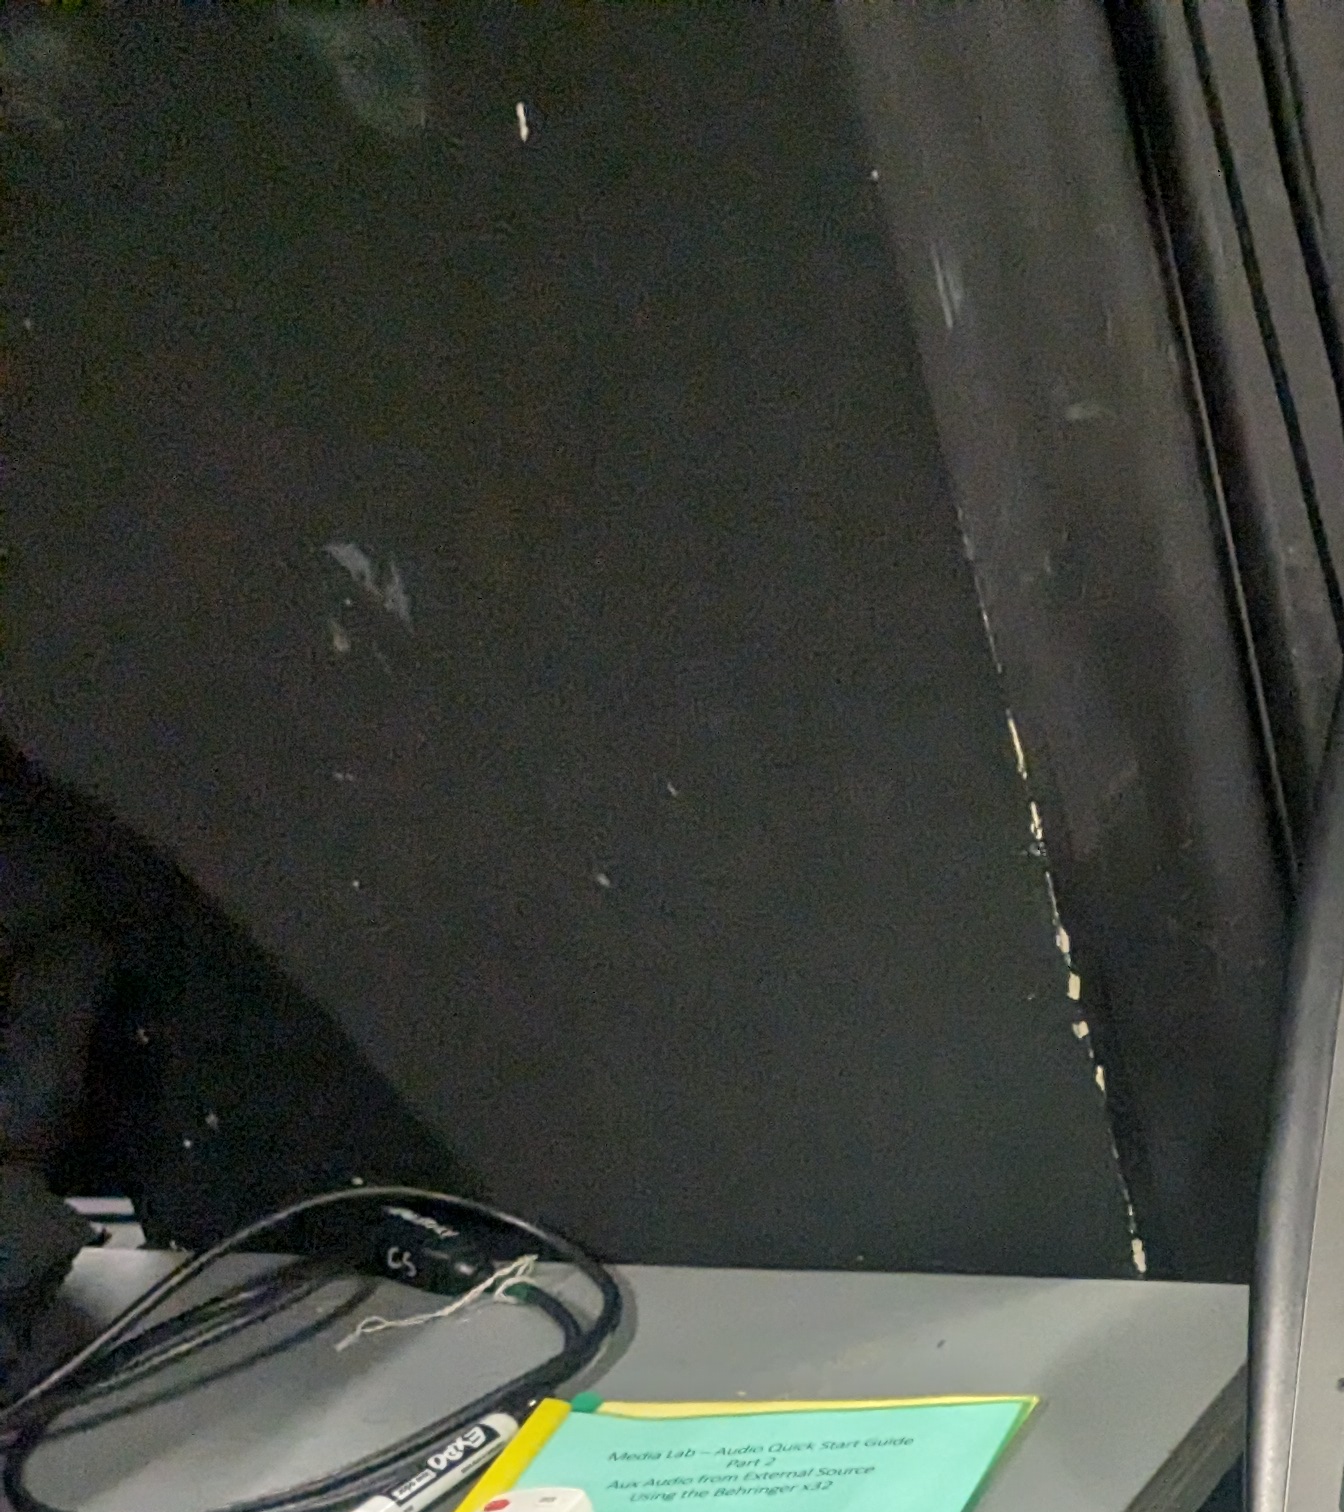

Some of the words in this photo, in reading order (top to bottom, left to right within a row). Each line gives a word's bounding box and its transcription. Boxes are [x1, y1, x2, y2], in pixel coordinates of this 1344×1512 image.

[427, 1426, 486, 1470] EXPO
[608, 1451, 662, 1461] Media
[666, 1448, 696, 1459] Lab
[714, 1444, 764, 1456] Audio
[768, 1442, 816, 1453] Quick
[820, 1440, 860, 1450] Start
[864, 1437, 914, 1447] Guide
[726, 1458, 761, 1468] Part
[765, 1457, 776, 1467] 2
[606, 1480, 639, 1490] Aux
[643, 1475, 694, 1487] Audio
[697, 1473, 738, 1484] from
[743, 1468, 814, 1481] External
[816, 1466, 875, 1477] Source
[630, 1491, 677, 1502] Using
[681, 1489, 709, 1499] the
[714, 1483, 798, 1498] Behringer
[801, 1480, 834, 1491] x32
